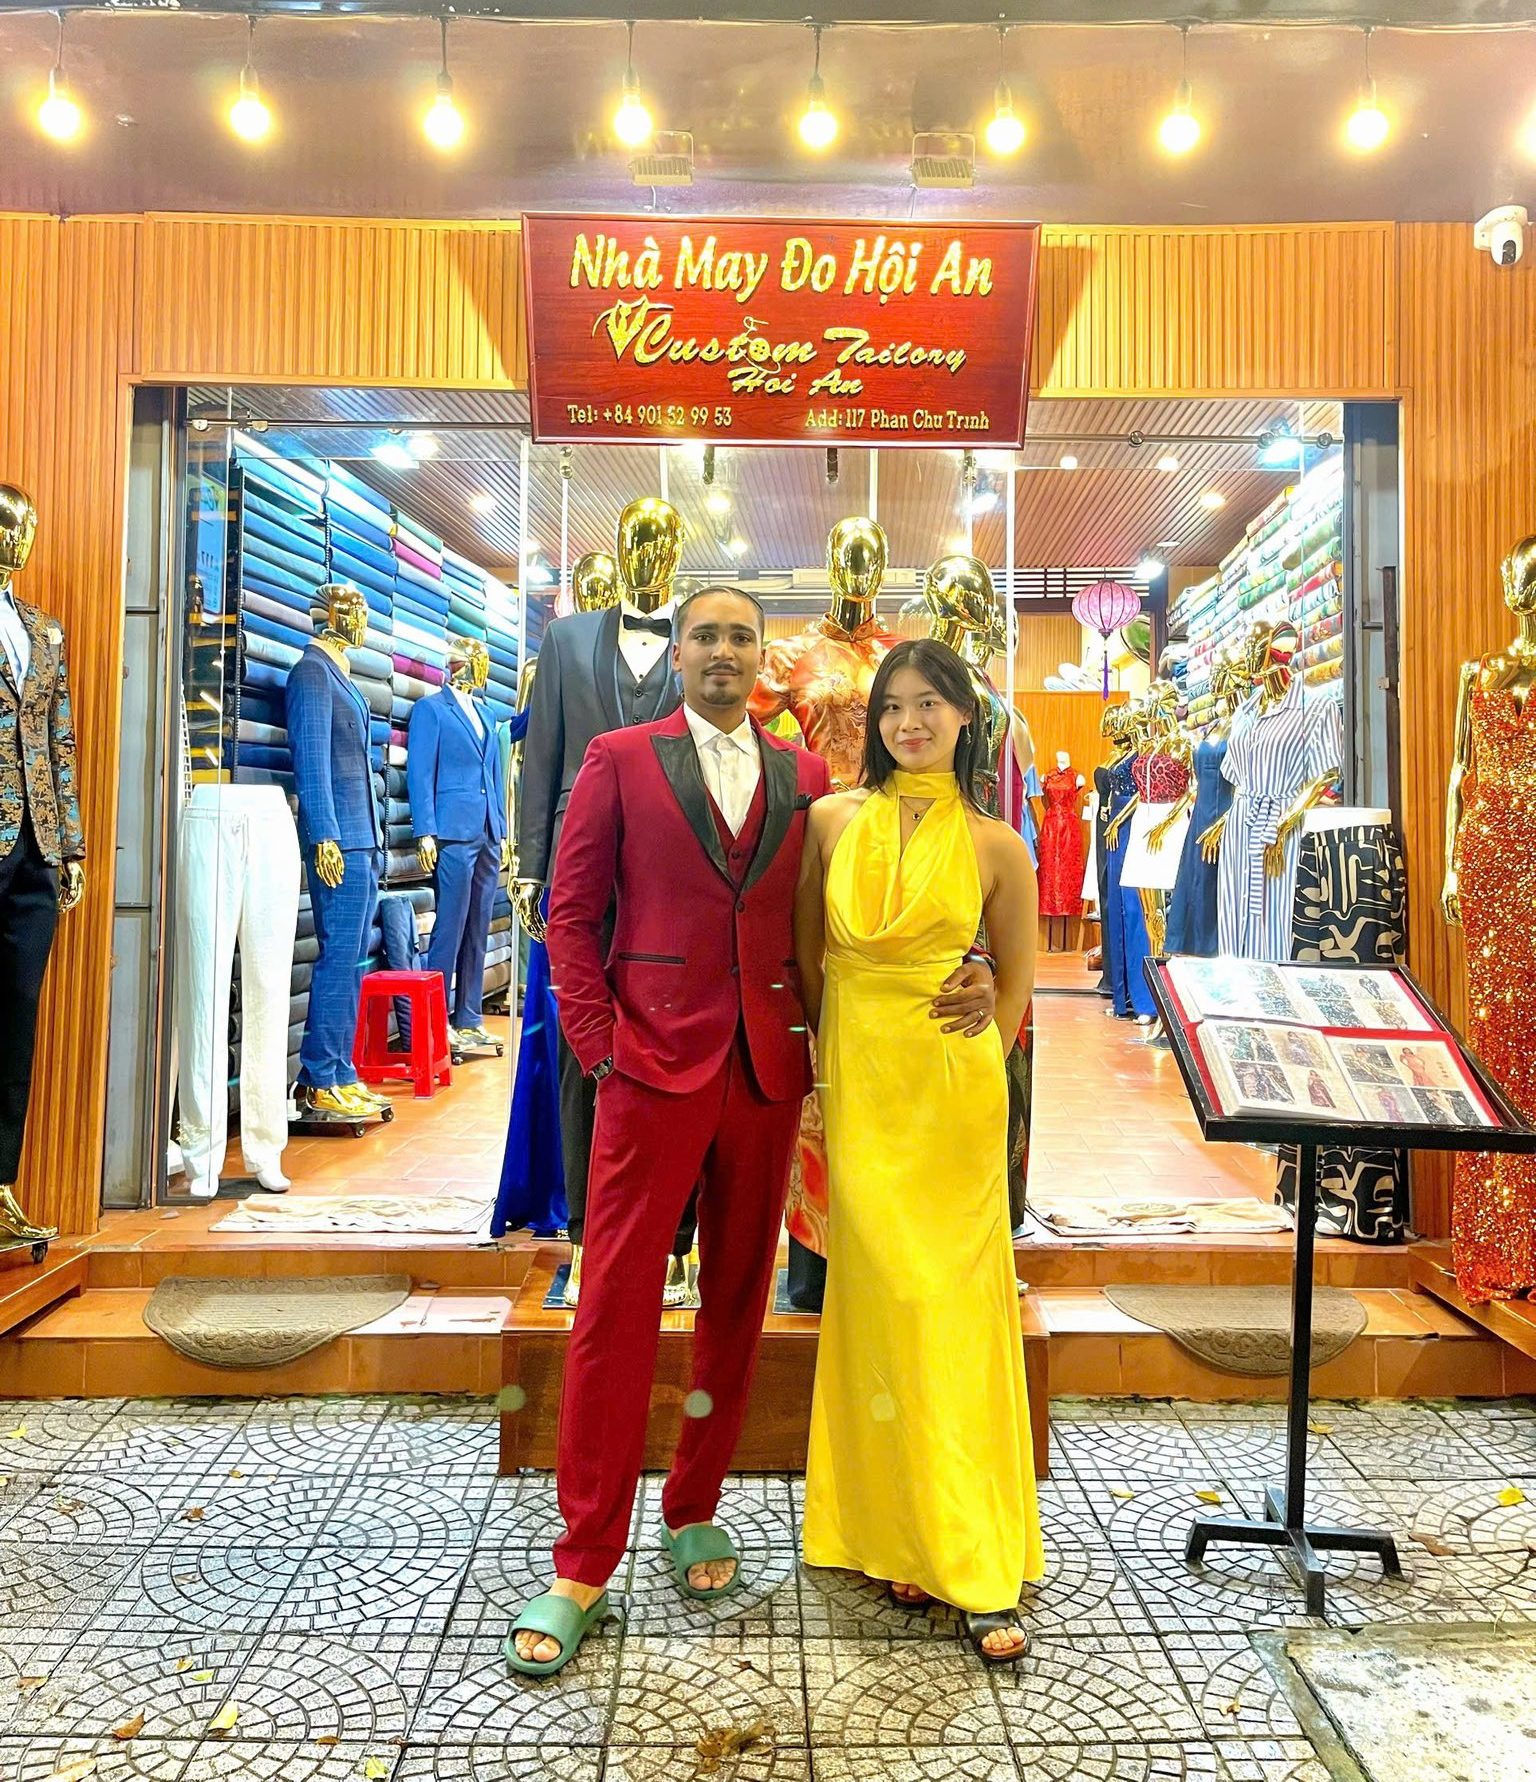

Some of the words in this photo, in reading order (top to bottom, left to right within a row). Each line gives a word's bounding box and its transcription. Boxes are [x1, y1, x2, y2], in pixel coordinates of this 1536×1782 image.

[569, 232, 664, 289] Nhà
[674, 235, 769, 304] May
[780, 236, 837, 293] Đo
[843, 234, 924, 305] Hội
[929, 239, 993, 296] An
[633, 312, 818, 366] Custom
[823, 326, 967, 373] Tailory
[726, 366, 798, 394] Hoi
[807, 367, 865, 396] An
[567, 404, 599, 424] Tel:
[602, 404, 634, 425] +84
[637, 405, 663, 426] 901
[667, 405, 686, 426] 52
[690, 406, 709, 427] 99
[713, 407, 733, 427] 53
[870, 409, 909, 430] Phan
[912, 409, 943, 430] Chu
